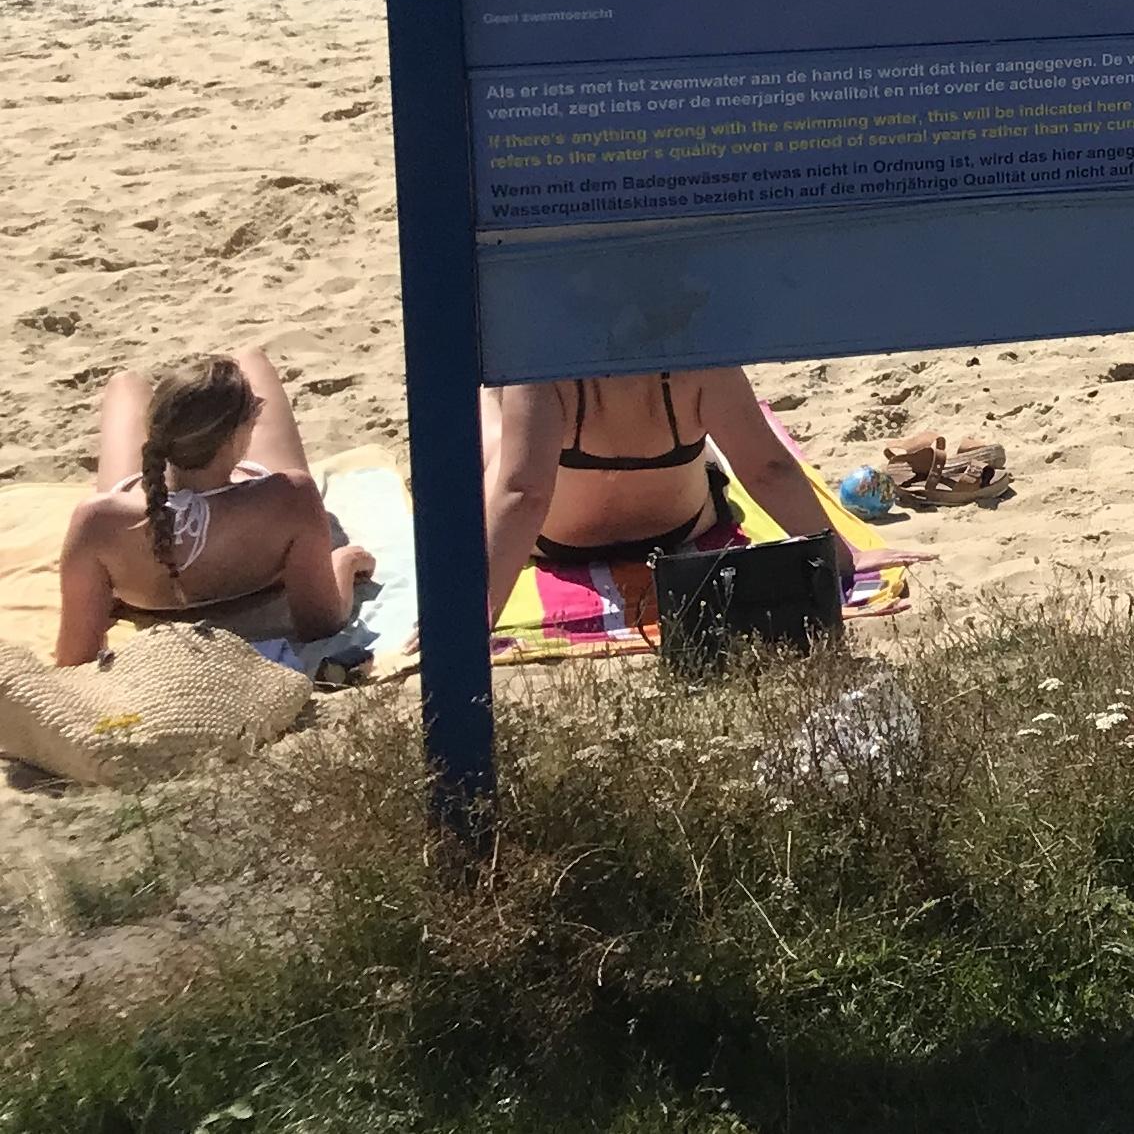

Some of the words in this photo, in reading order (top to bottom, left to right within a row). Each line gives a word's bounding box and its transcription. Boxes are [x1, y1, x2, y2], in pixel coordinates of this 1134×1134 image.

[486, 85, 514, 99] Als
[520, 87, 537, 97] er
[543, 81, 574, 96] iets
[579, 79, 611, 94] met
[617, 78, 645, 92] het
[648, 72, 746, 90] zwemwater
[751, 74, 780, 85] aan
[786, 69, 806, 83] de
[811, 67, 852, 81] hand
[858, 66, 872, 79] is
[877, 63, 924, 78] wordt
[929, 61, 955, 75] dat
[959, 60, 991, 73] hier
[995, 57, 1096, 75] aangegeven.
[1102, 53, 1122, 66] De
[568, 100, 605, 118] zegt
[611, 98, 641, 113] iets
[647, 99, 684, 111] over
[690, 95, 709, 108] de
[716, 89, 804, 110] meerjarige
[810, 85, 879, 101] kwaliteit
[884, 87, 903, 97] en
[909, 82, 939, 96] niet
[944, 83, 979, 94] over
[984, 78, 1004, 92] de
[1009, 75, 1066, 90] actuele
[488, 135, 499, 149] If
[571, 126, 646, 147] anything
[653, 126, 704, 142] wrong
[711, 121, 746, 135] with
[751, 119, 777, 133] the
[783, 114, 867, 134] swimming
[873, 110, 922, 127] water,
[927, 108, 957, 122] this
[962, 106, 989, 120] will
[995, 105, 1014, 118] be
[1019, 100, 1091, 117] indicated
[490, 153, 541, 168] refers
[546, 152, 560, 165] to
[568, 150, 595, 164] the
[601, 146, 663, 162] waters
[669, 142, 726, 161] quality
[732, 143, 767, 153] over
[774, 142, 783, 151] a
[788, 135, 840, 153] period
[847, 134, 863, 146] of
[868, 130, 926, 145] several
[932, 130, 975, 144] years
[981, 124, 1027, 138] rather
[1034, 121, 1068, 135] than
[1073, 122, 1100, 135] any
[490, 182, 541, 198] Wenn
[547, 180, 574, 194] mit
[579, 177, 616, 192] dem
[622, 168, 748, 192] Badegewässer
[753, 165, 801, 181] etwas
[806, 162, 848, 177] nicht
[853, 161, 867, 174] in
[873, 156, 945, 176] Ordnung
[950, 154, 974, 169] ist,
[979, 151, 1013, 166] wird
[1018, 149, 1047, 163] das
[1052, 147, 1082, 161] hier
[491, 193, 688, 221] Wasserqualitätsklasse
[693, 188, 754, 205] bezieht
[759, 186, 794, 200] sich
[799, 183, 825, 197] auf
[830, 181, 855, 195] die
[860, 175, 957, 196] mehrjährige
[962, 170, 1025, 186] Qualität
[1031, 168, 1060, 182] und
[1065, 165, 1104, 179] nicht
[1109, 163, 1133, 176] auf
